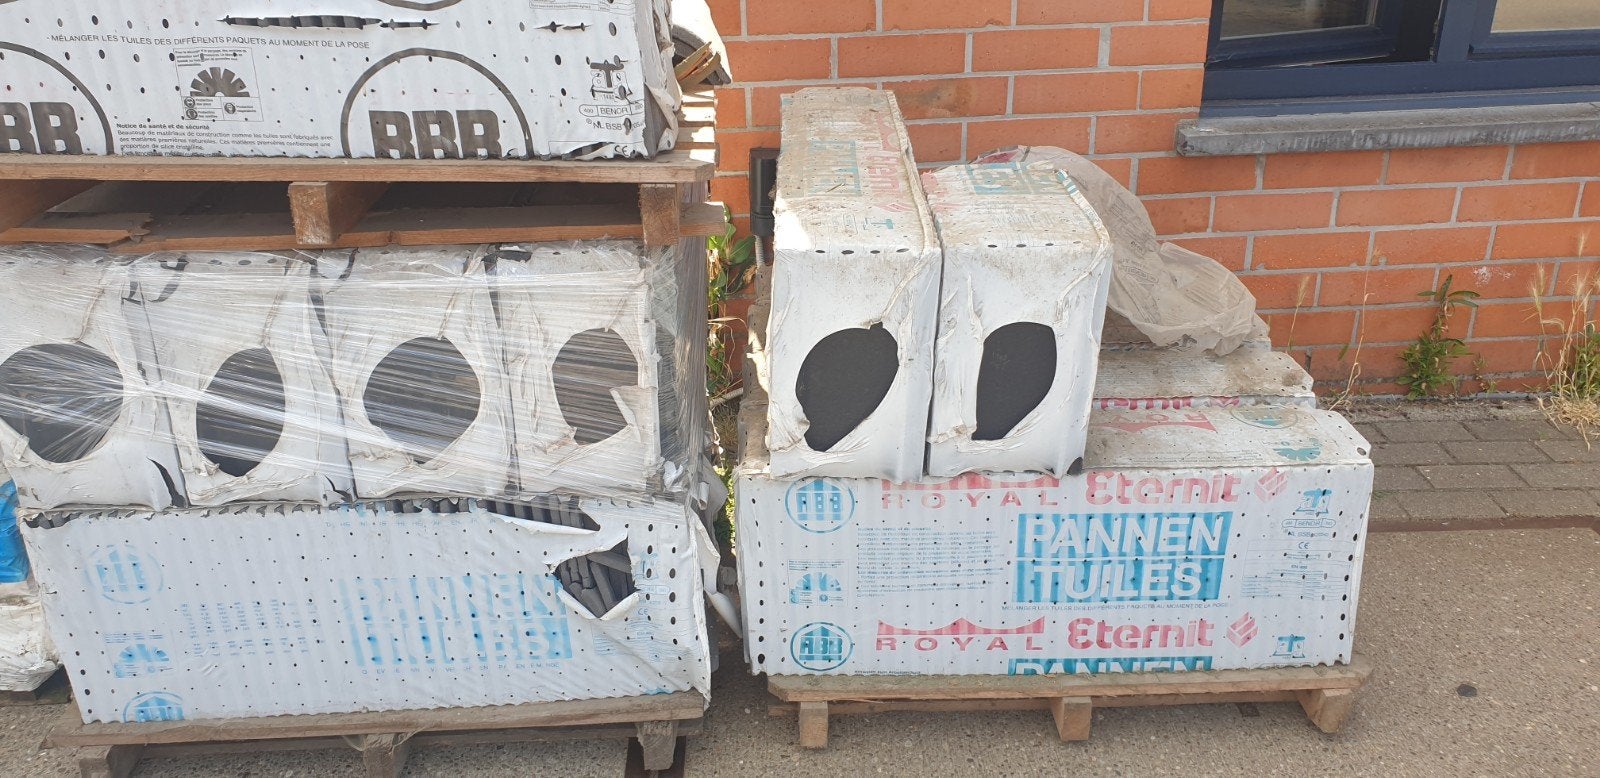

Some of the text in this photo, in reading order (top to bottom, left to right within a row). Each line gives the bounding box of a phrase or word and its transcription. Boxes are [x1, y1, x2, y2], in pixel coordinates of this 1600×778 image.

[51, 34, 100, 43] MÉLANGER
[121, 36, 152, 45] TUILES
[226, 36, 267, 45] PAQUETS
[282, 39, 320, 47] MOMENT
[321, 40, 333, 48] DE
[347, 41, 370, 49] POSE
[599, 107, 629, 116] BENOR
[881, 470, 1242, 510] ROYAL Eternit
[1022, 513, 1224, 556] PANNEN
[1032, 560, 1204, 601] TUILES
[875, 616, 1215, 651] ROYAL Eternit
